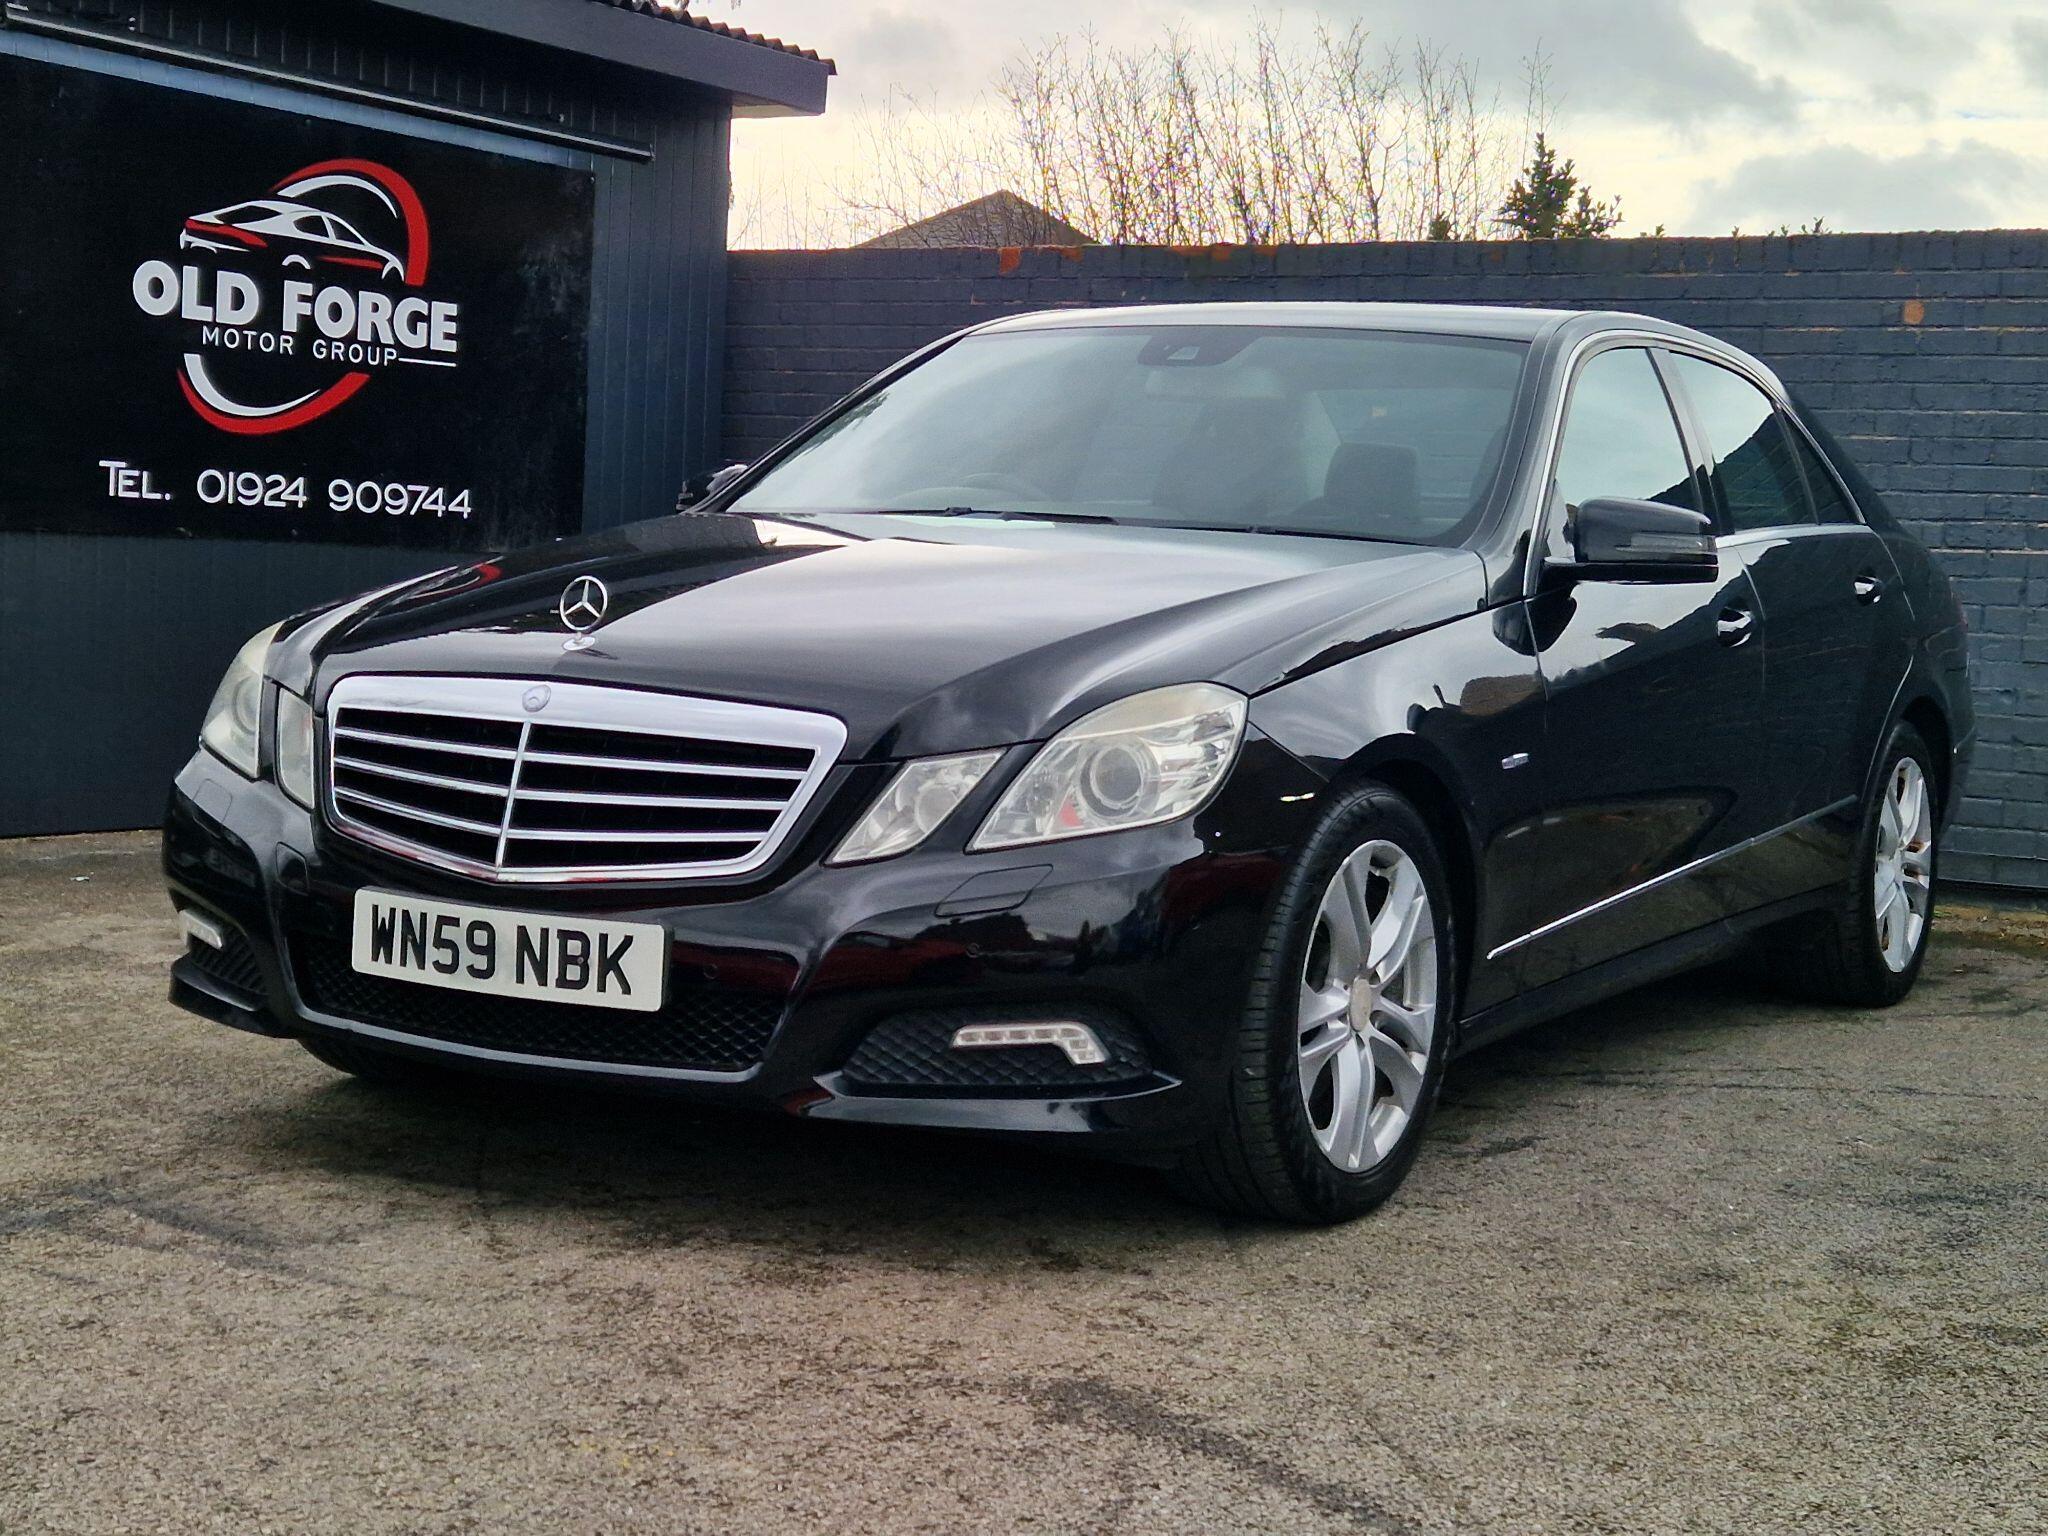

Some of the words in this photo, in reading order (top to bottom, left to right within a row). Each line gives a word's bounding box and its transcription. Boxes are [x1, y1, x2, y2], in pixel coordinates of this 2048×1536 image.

[133, 260, 259, 325] OLD
[283, 280, 457, 352] FORGE
[203, 326, 293, 355] MOTOR
[313, 339, 396, 367] GROUP
[99, 461, 170, 501] TEL.
[197, 469, 307, 508] 01924
[329, 479, 471, 518] 909744
[372, 904, 496, 979] WN59
[516, 925, 633, 995] NBK
